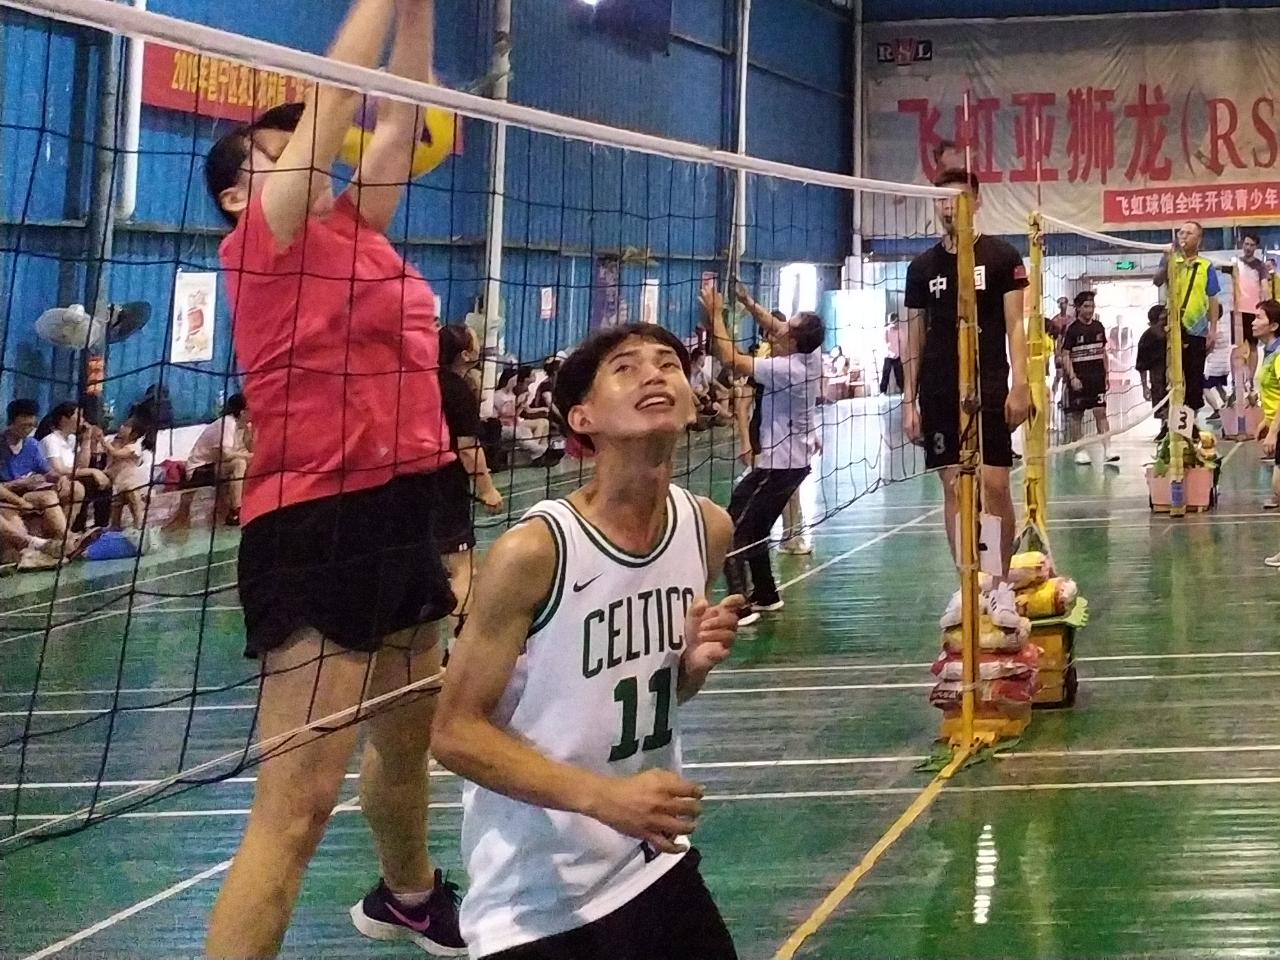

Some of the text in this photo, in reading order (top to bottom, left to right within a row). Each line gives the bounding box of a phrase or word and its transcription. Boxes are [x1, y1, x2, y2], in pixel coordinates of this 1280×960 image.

[878, 41, 933, 63] RSL
[1178, 411, 1188, 431] 3
[608, 667, 673, 762] 11
